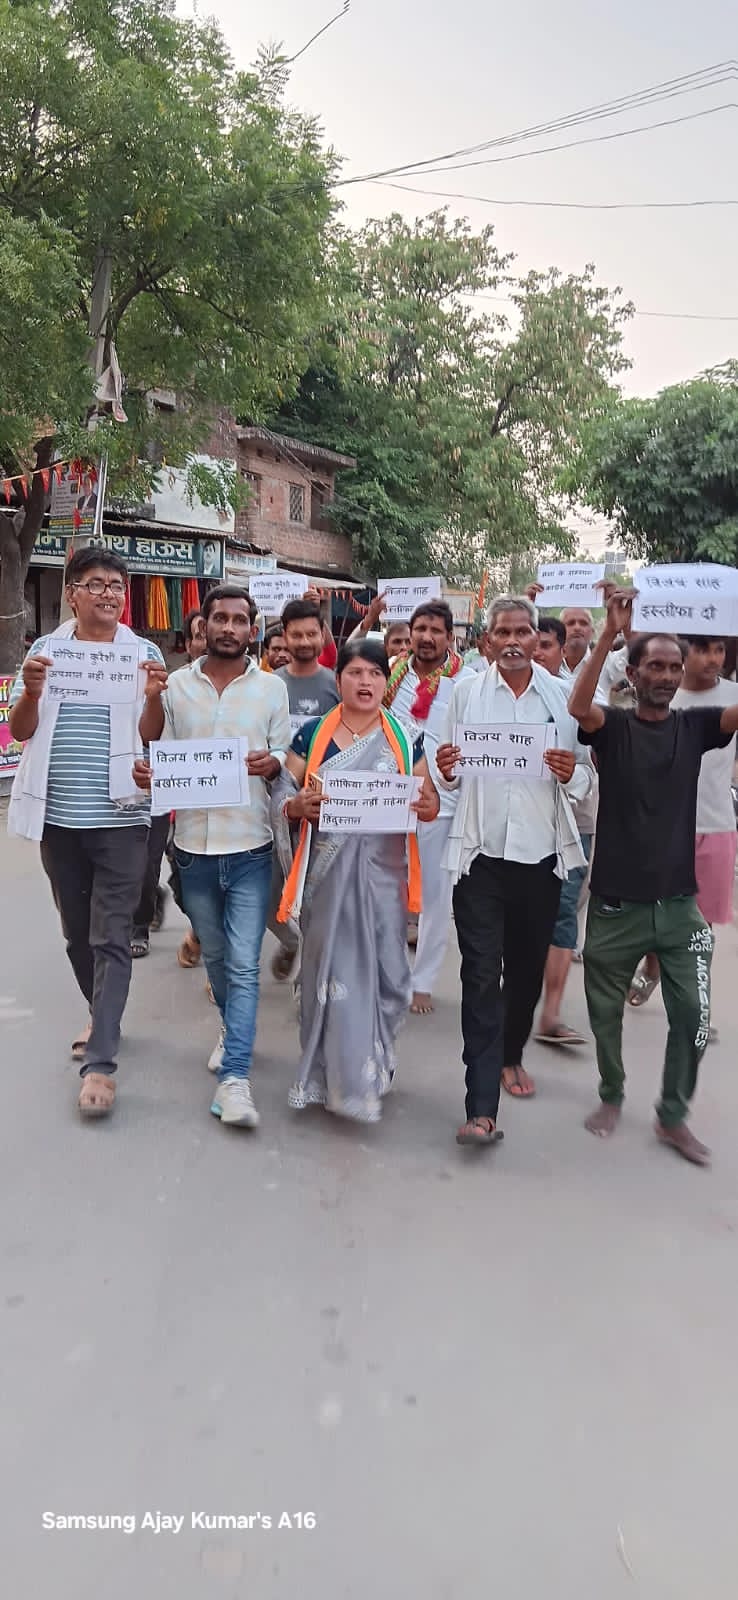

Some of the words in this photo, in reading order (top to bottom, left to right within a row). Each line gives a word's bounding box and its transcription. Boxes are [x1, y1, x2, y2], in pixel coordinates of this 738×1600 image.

[135, 536, 195, 559] हाऊस
[120, 654, 132, 663] का
[464, 730, 502, 742] विजय
[509, 733, 534, 746] शाह
[156, 750, 187, 763] विजय
[193, 751, 213, 763] शाह
[218, 749, 232, 761] को
[459, 753, 507, 768] इस्तीफा
[514, 756, 528, 768] दो
[197, 773, 218, 787] करो
[395, 782, 408, 790] का
